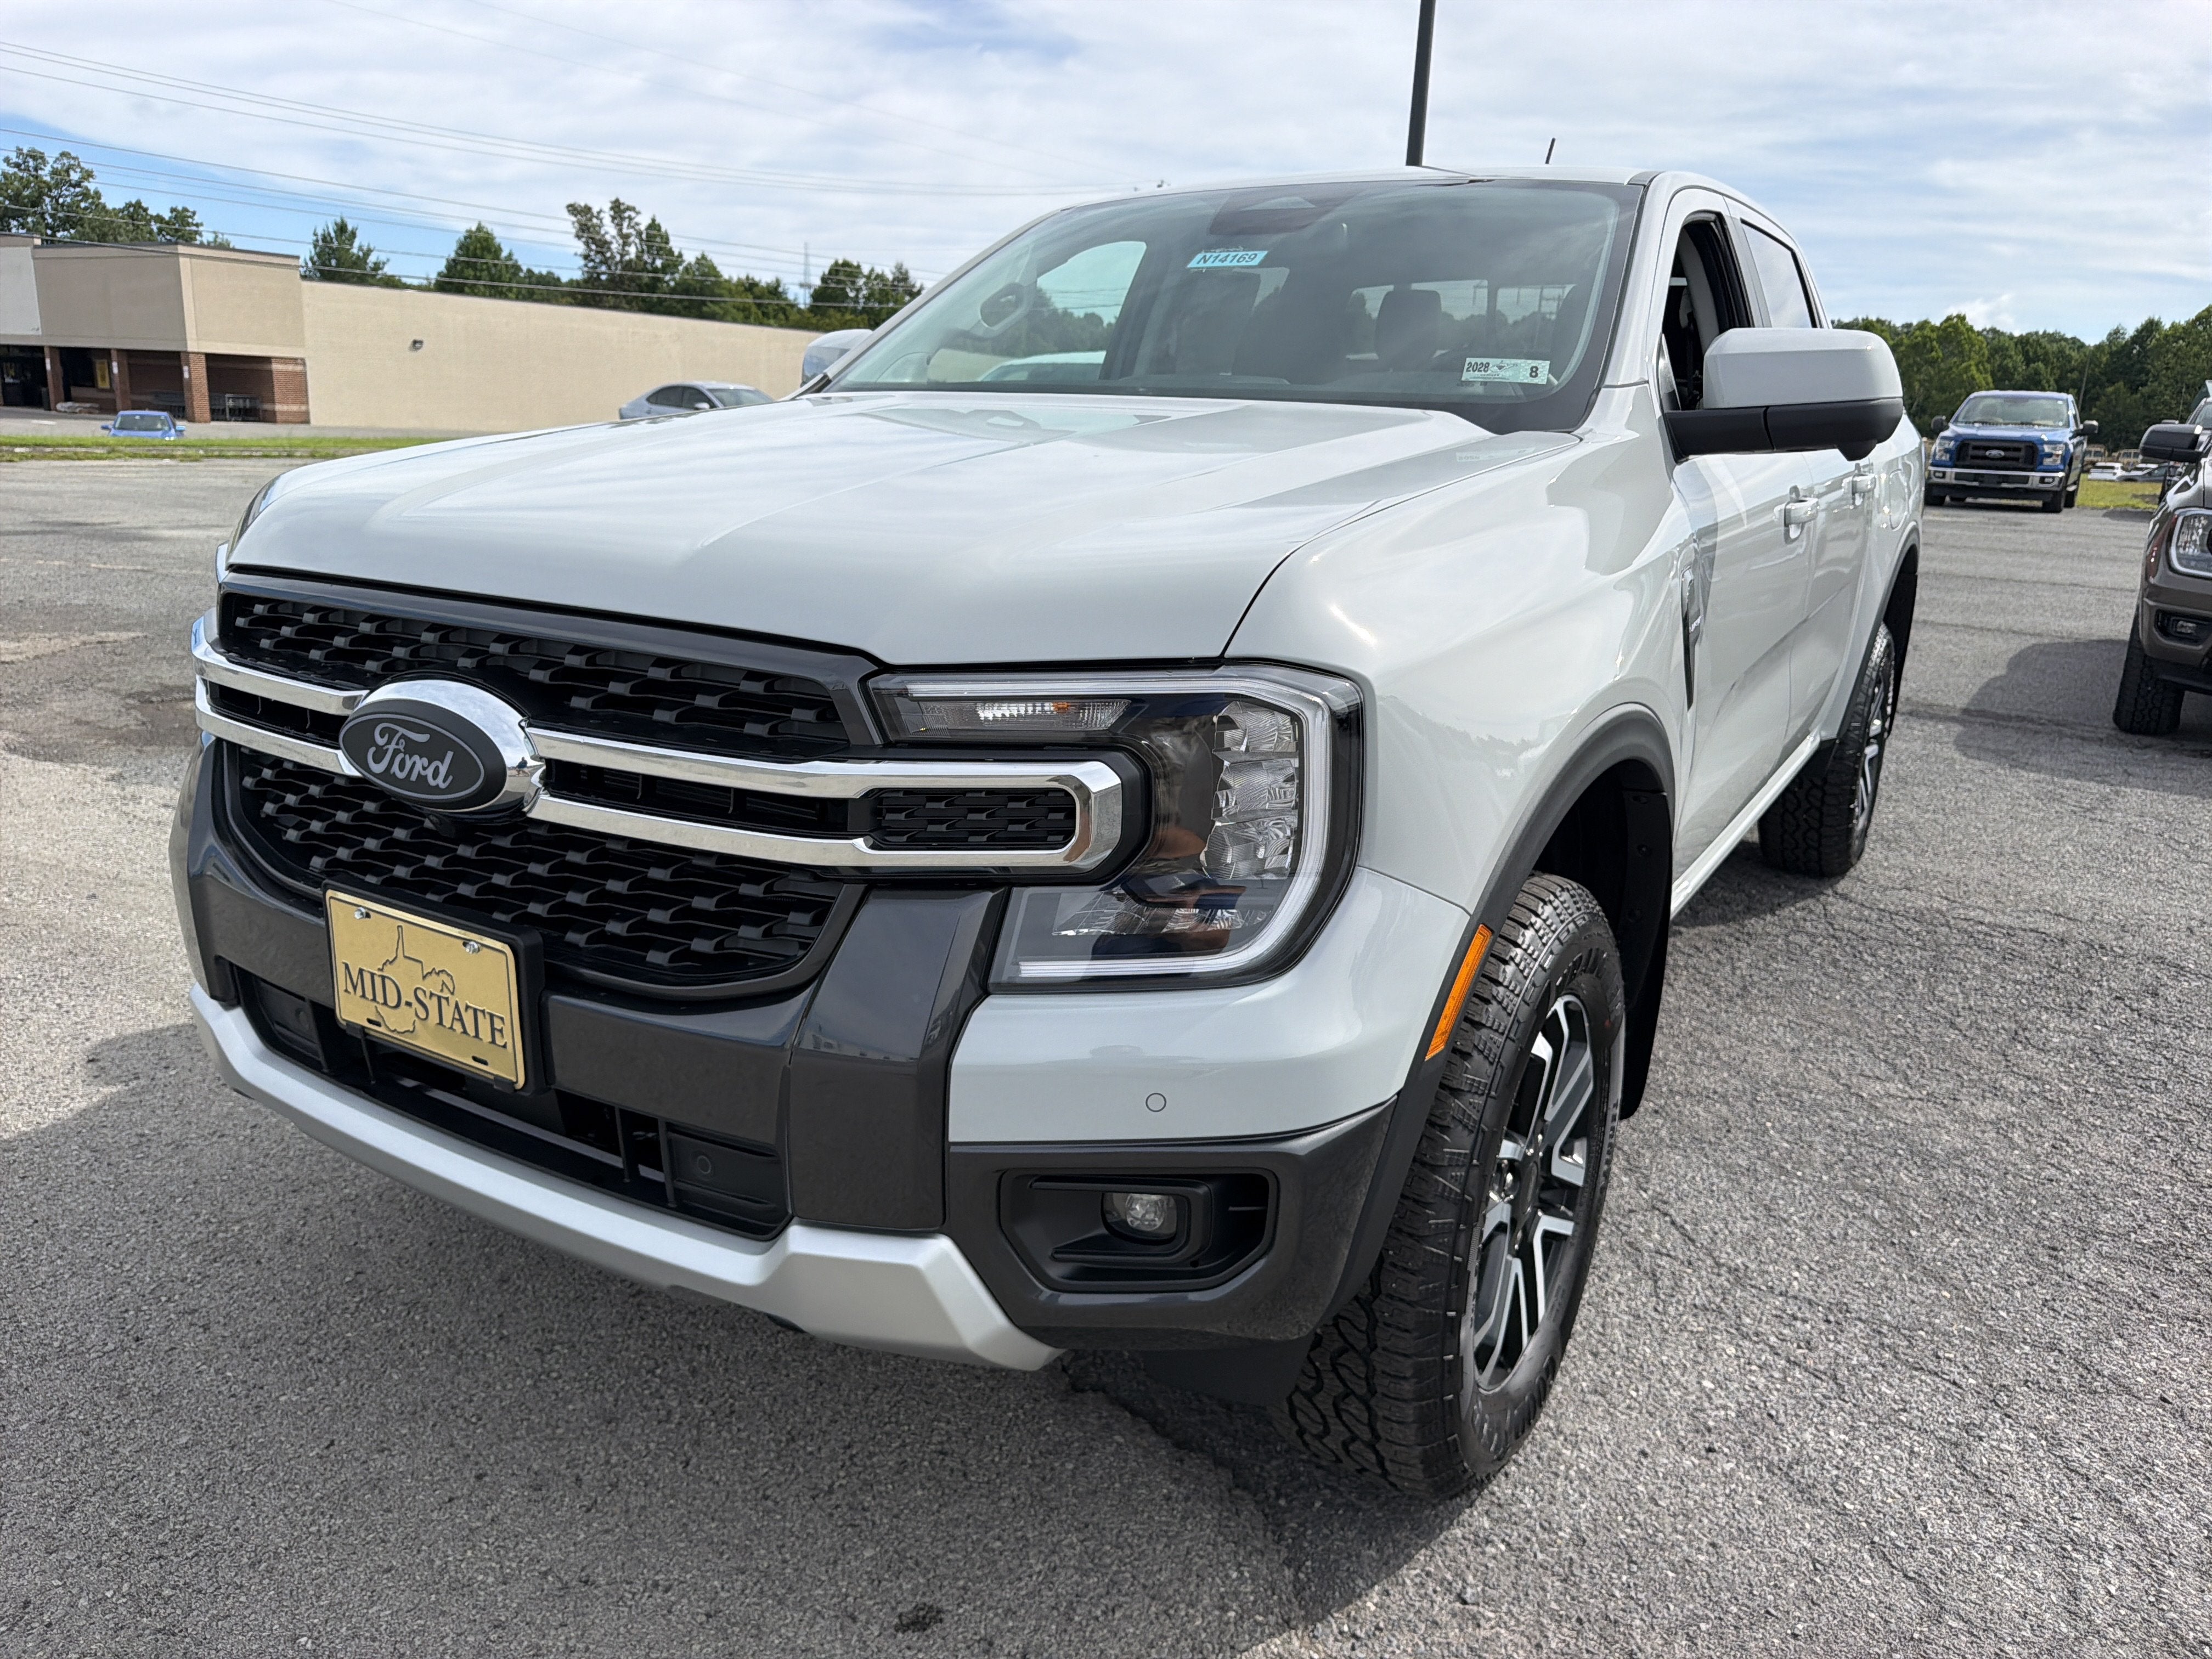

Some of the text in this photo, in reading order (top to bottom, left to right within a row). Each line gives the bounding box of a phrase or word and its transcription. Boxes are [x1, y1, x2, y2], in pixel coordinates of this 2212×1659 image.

[1197, 253, 1258, 264] N14169
[1465, 362, 1539, 379] 2028 8
[367, 723, 454, 788] Ford
[342, 960, 507, 1048] MID-STATE
